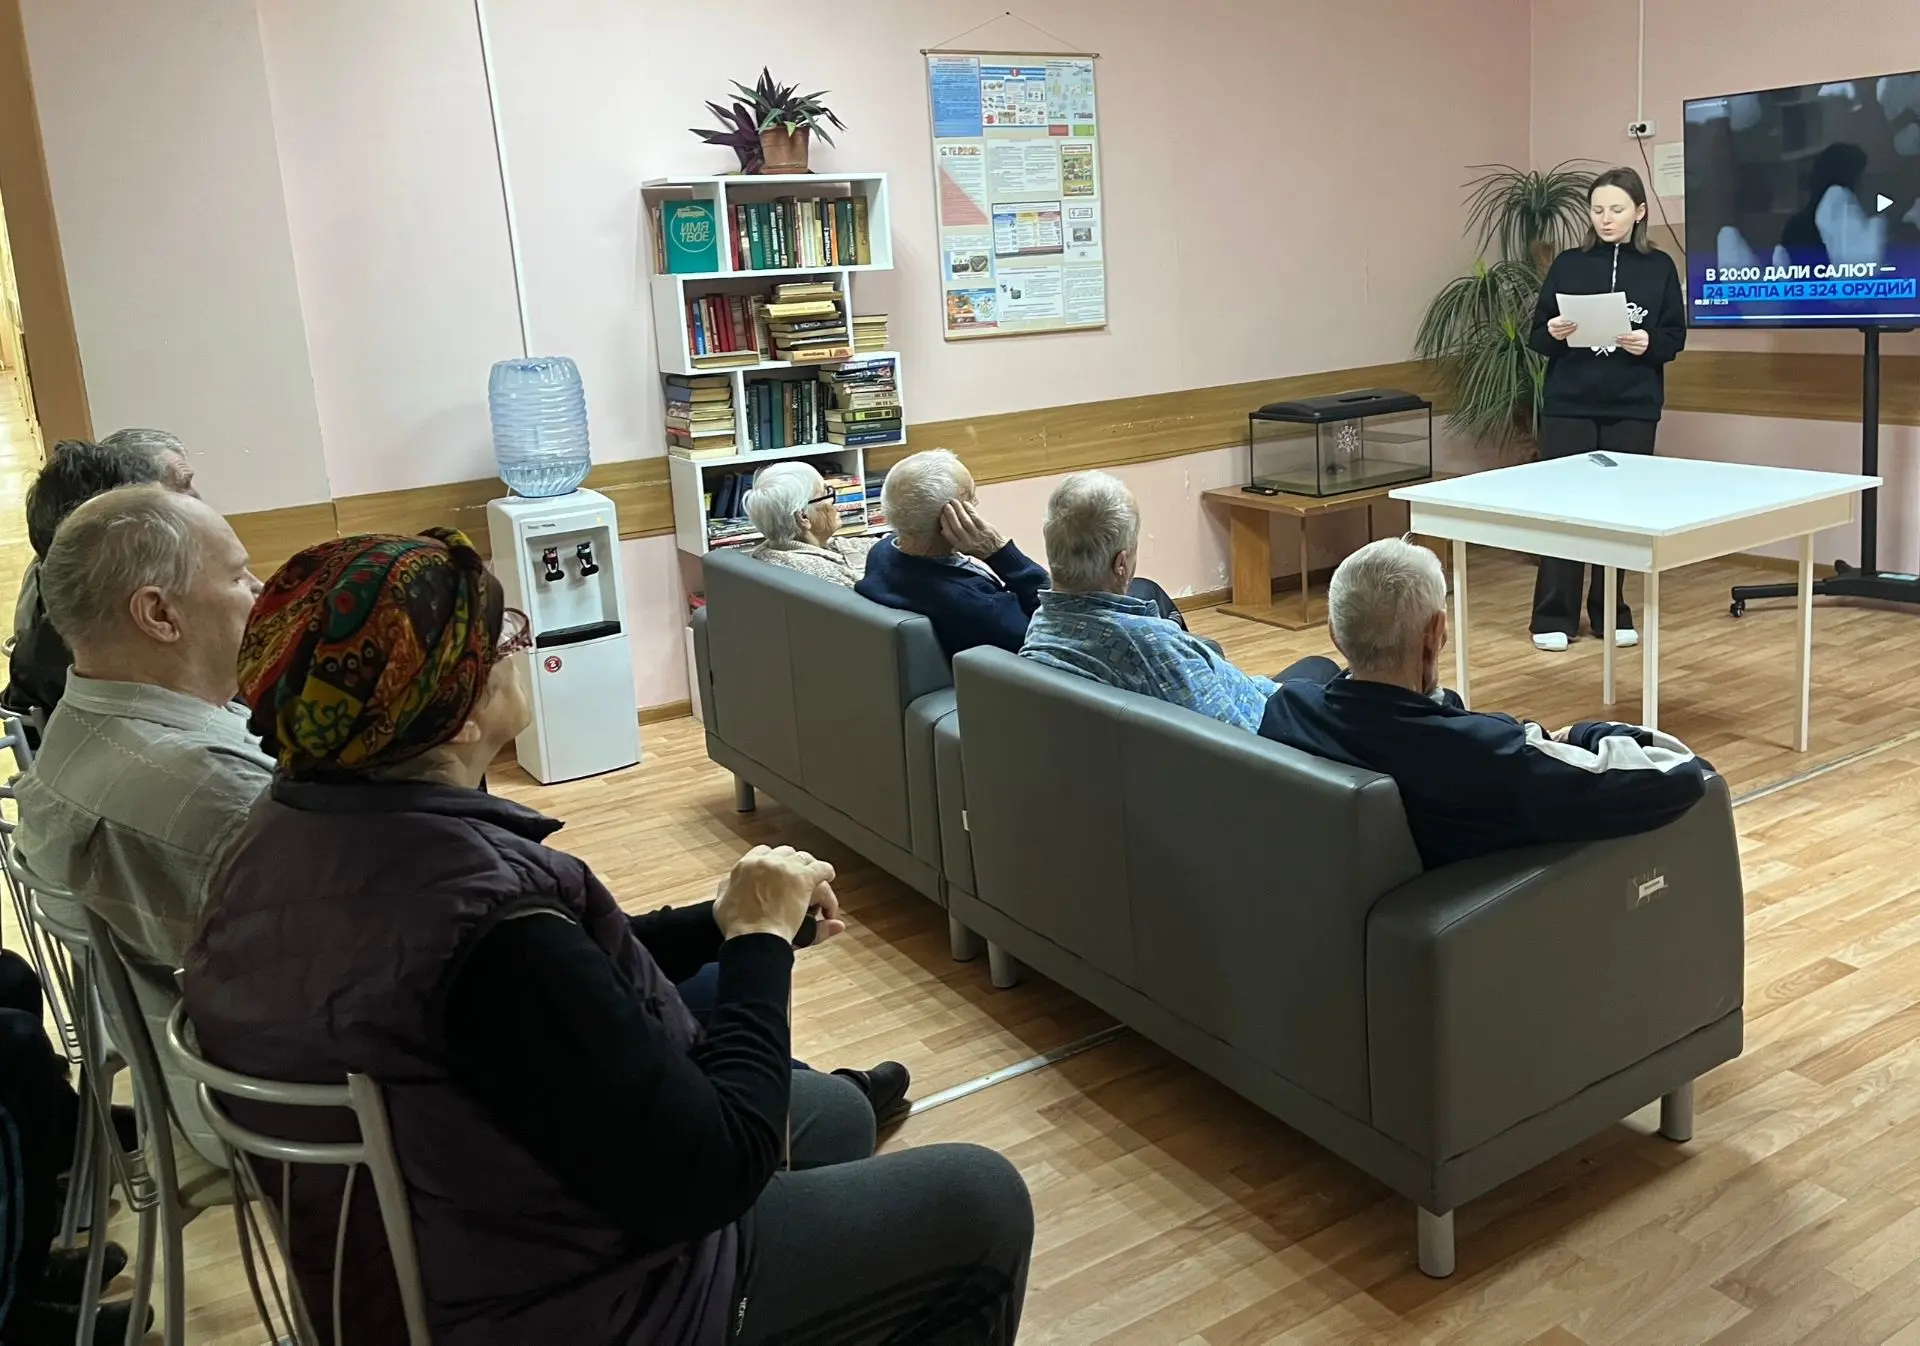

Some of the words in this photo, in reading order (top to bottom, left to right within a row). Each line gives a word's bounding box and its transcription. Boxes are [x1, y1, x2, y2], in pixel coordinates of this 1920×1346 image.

[680, 221, 709, 233] ИМЯ
[680, 231, 710, 243] ТВОЕ
[1705, 268, 1716, 281] В
[1719, 266, 1760, 281] 20:00
[1763, 264, 1810, 282] ДАЛИ
[1813, 262, 1877, 279] САЛЮТ
[1706, 286, 1723, 299] 24
[1727, 284, 1779, 298] ЗАЛПА
[1783, 284, 1805, 297] ИЗ
[1808, 283, 1837, 297] 324
[1841, 278, 1913, 298] ОРУДИЙ
